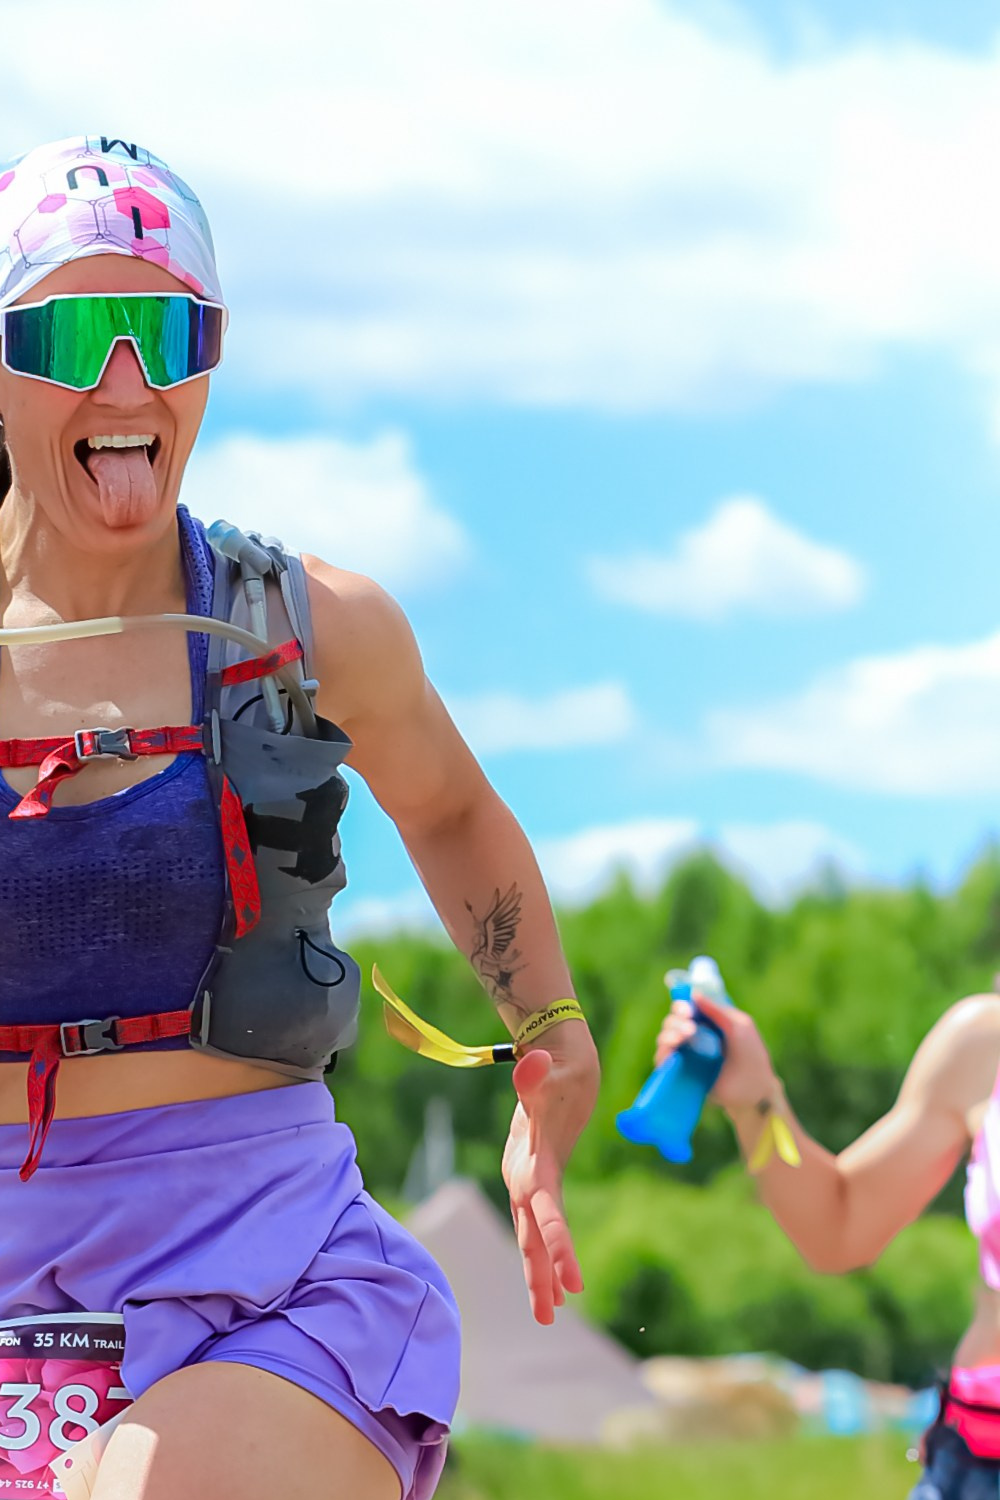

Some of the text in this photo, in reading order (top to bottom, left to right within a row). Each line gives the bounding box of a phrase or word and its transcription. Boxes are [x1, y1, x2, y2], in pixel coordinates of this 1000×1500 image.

[33, 1332, 125, 1350] 35 KM TRAIL
[15, 1479, 34, 1489] 925
